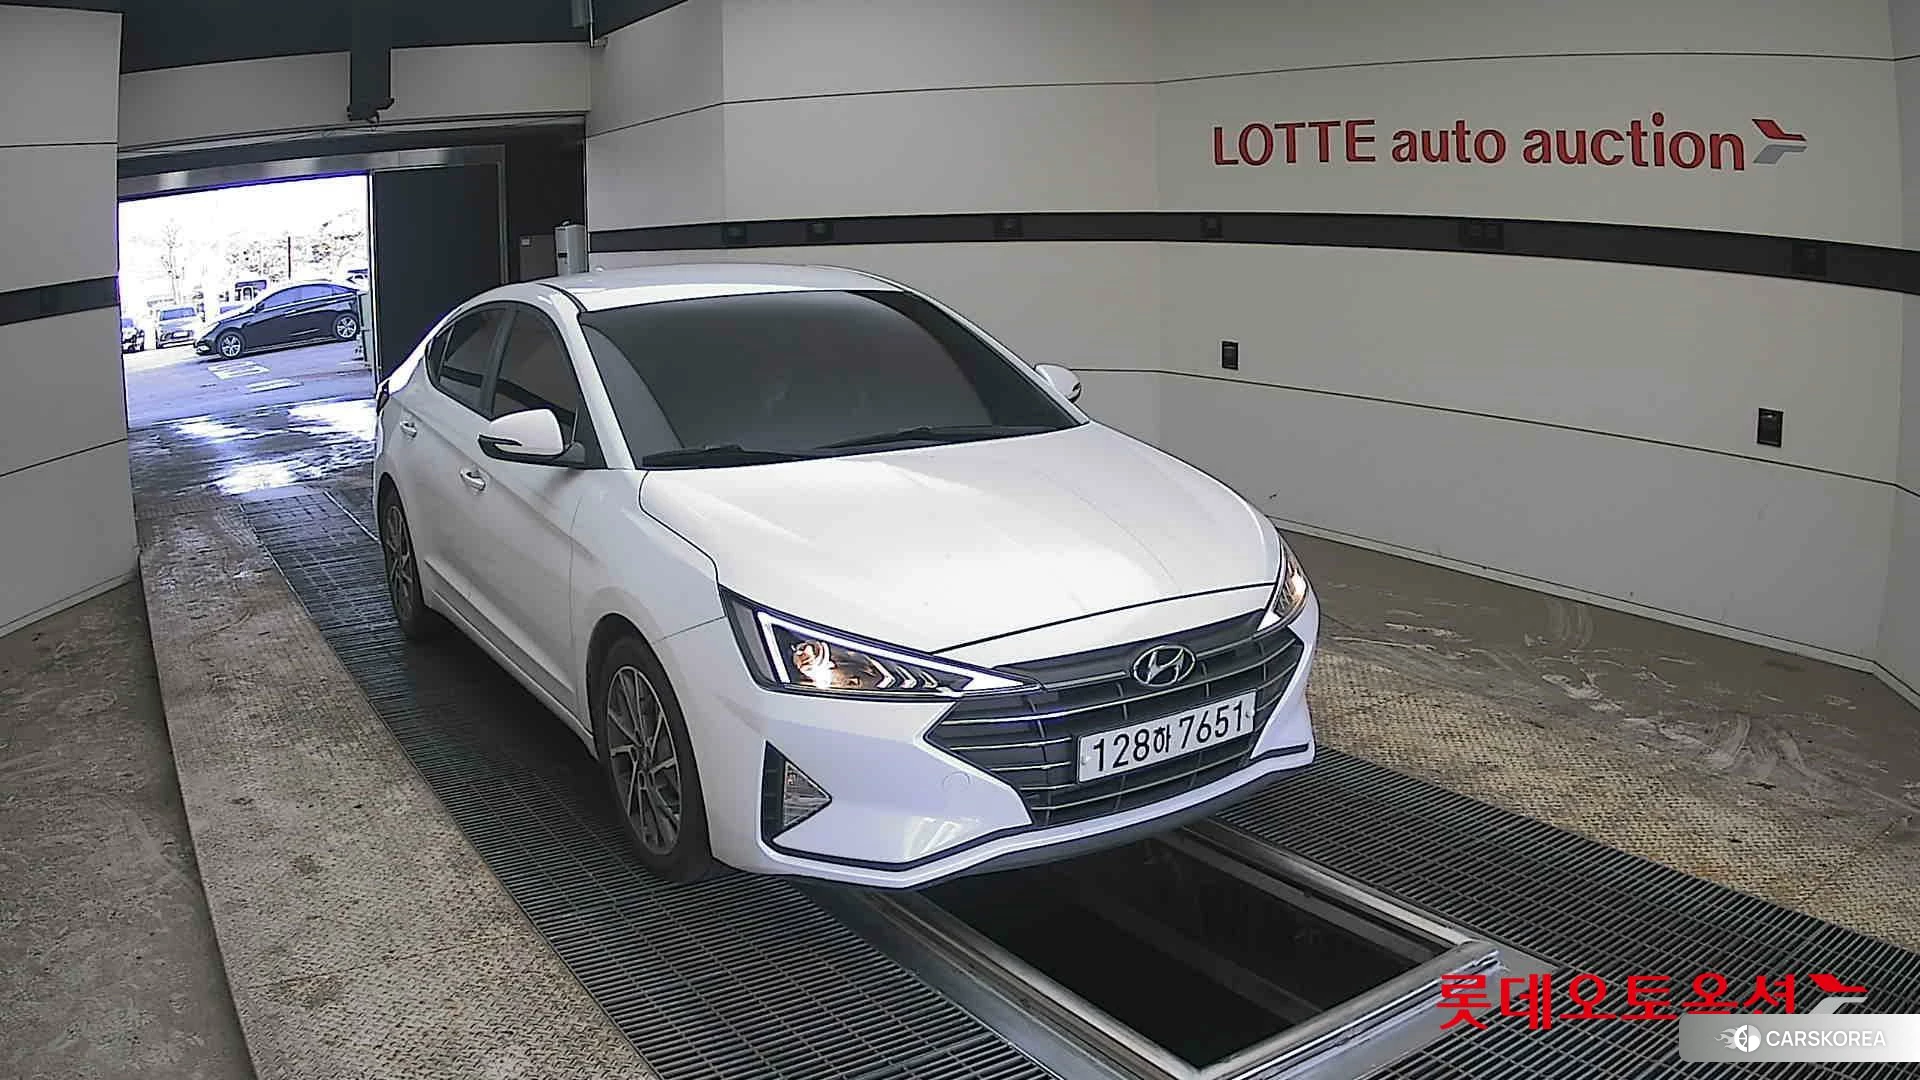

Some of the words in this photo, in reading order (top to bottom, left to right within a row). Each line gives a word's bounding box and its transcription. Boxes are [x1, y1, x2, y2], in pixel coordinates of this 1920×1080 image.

[1213, 119, 1377, 166] LOTTE
[1391, 120, 1507, 164] auto
[1522, 111, 1746, 171] auction
[1093, 723, 1171, 772] 128하
[1179, 699, 1243, 749] 7651
